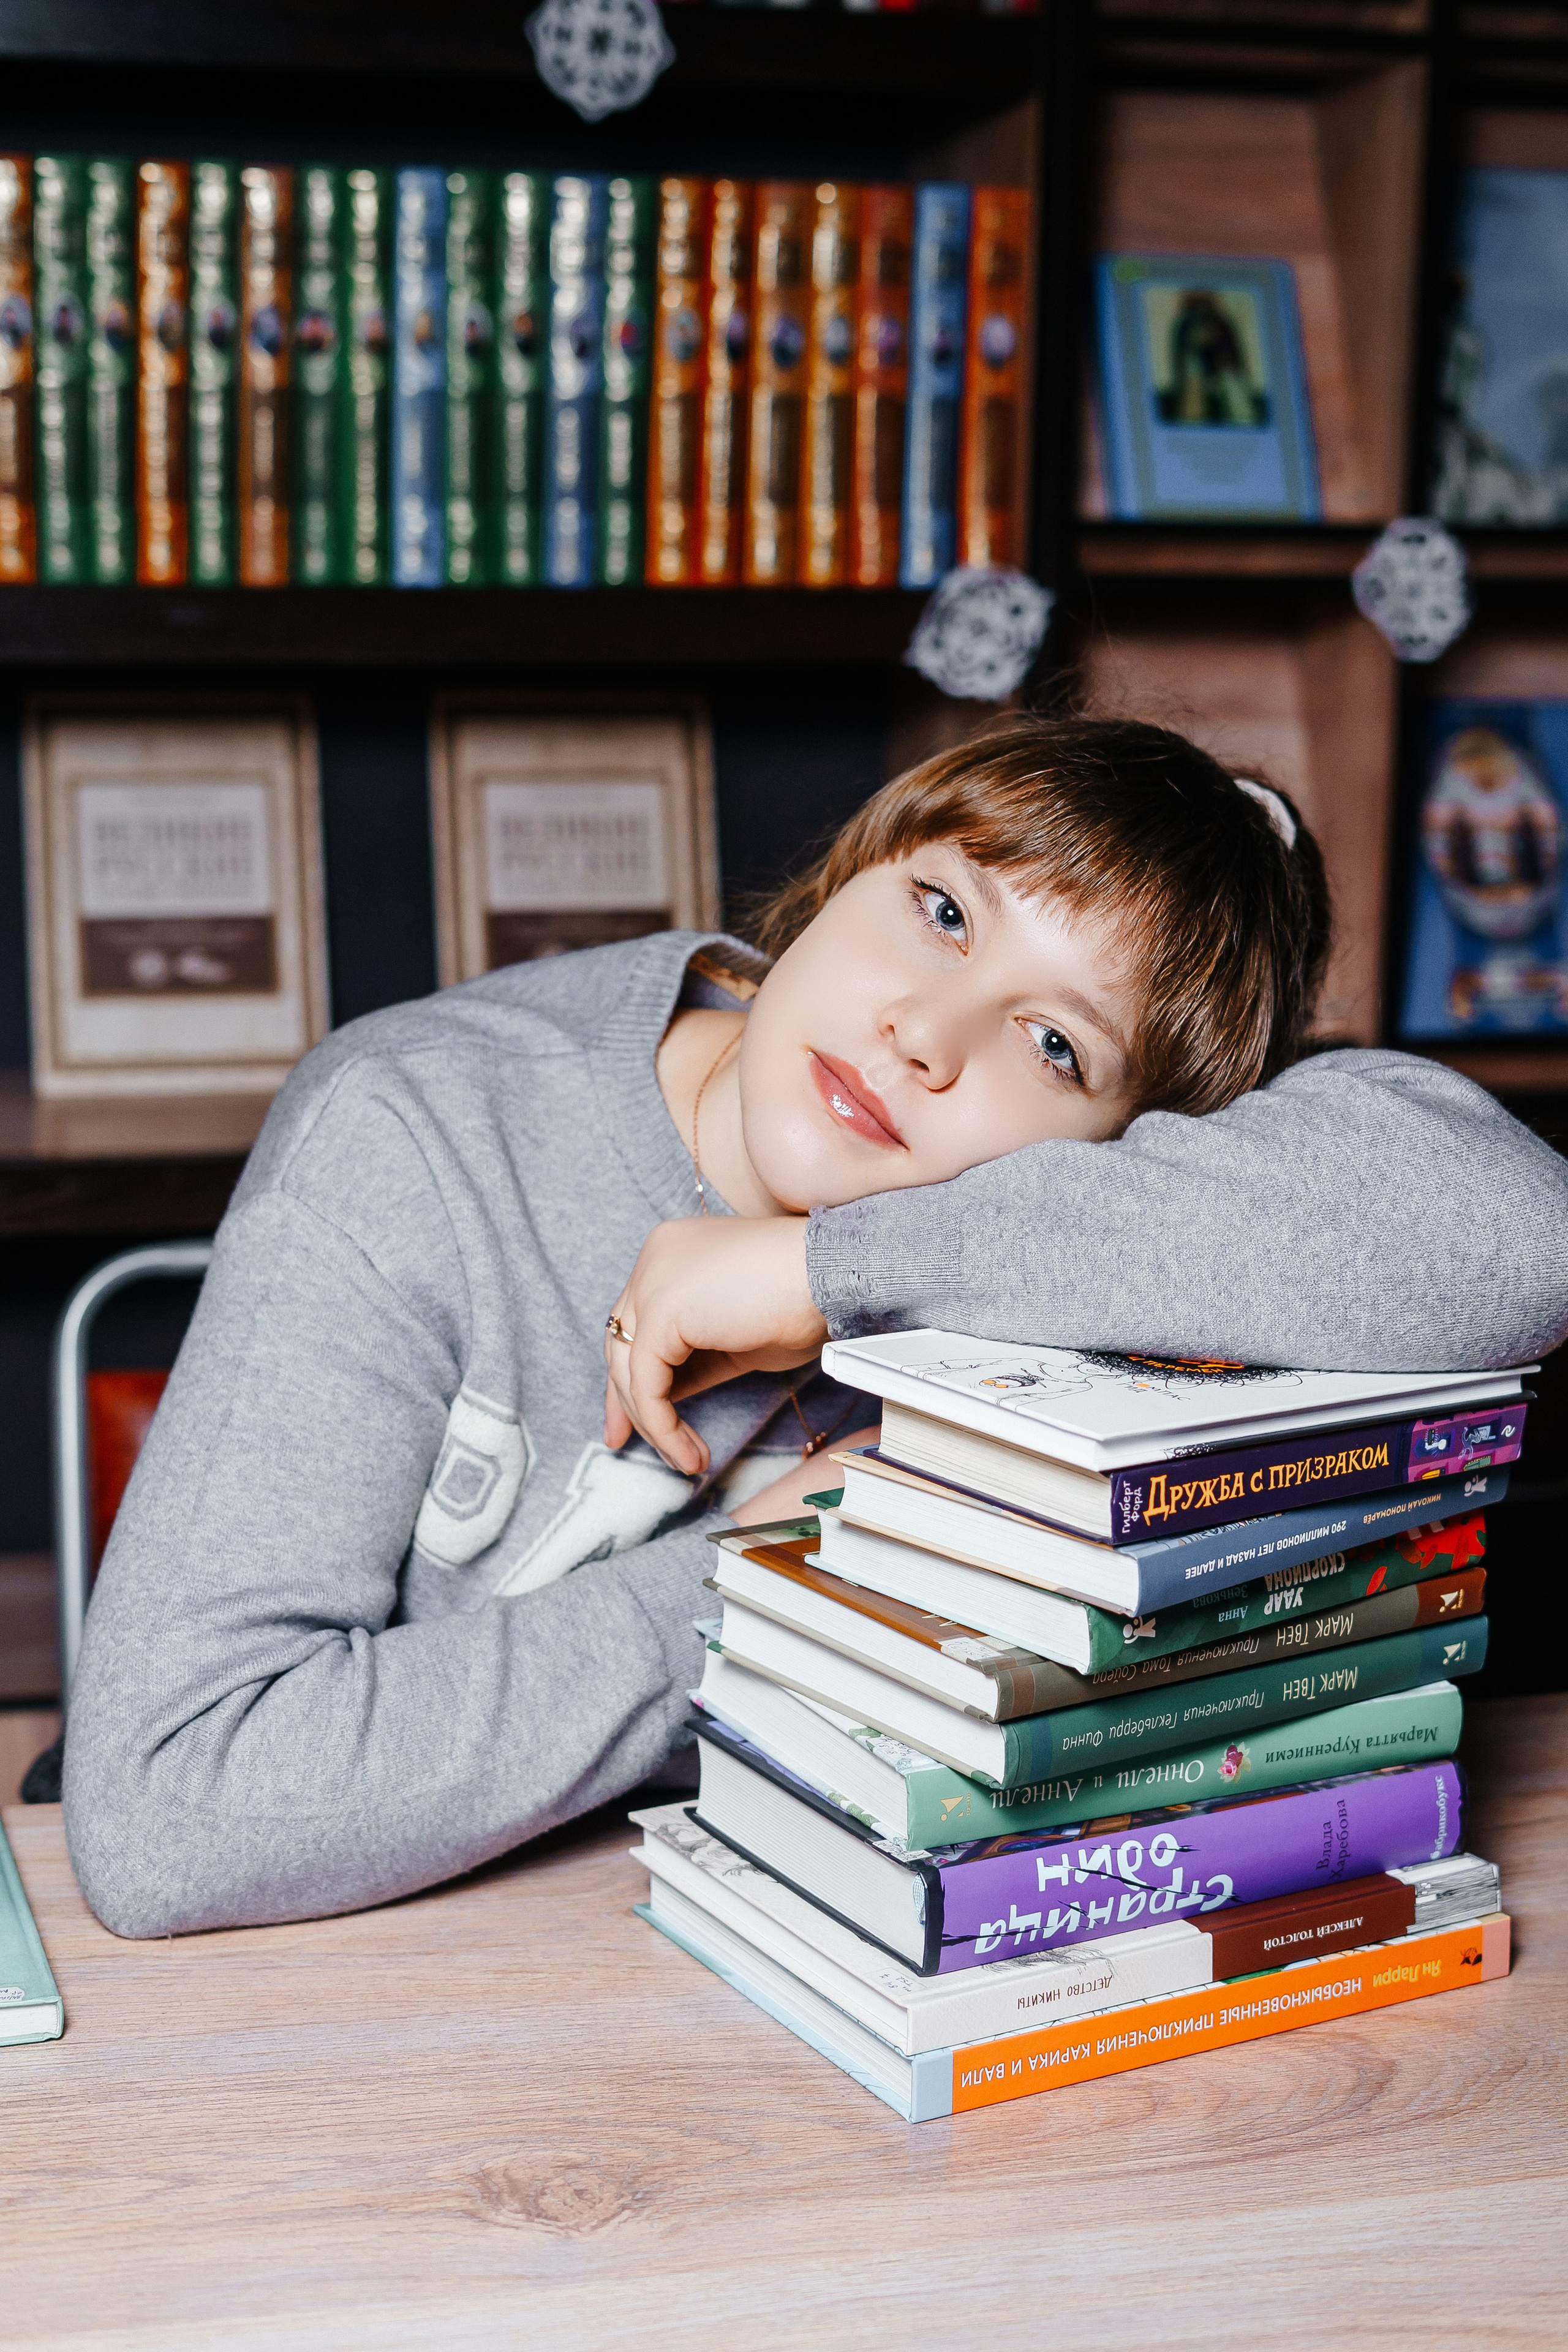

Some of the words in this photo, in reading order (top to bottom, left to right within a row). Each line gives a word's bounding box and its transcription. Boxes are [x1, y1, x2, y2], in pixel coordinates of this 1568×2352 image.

[1143, 1360, 1224, 1373] ПЕРЕМЕН
[1267, 1442, 1390, 1491] ПРИЗРАКОМ
[1130, 1487, 1144, 1522] Форд
[1362, 1502, 1407, 1525] ПОНОМАРЁВ
[1408, 1493, 1442, 1513] НИКОЛАЙ
[1276, 1523, 1330, 1552] МИЛЛИОНОВ
[1331, 1520, 1347, 1534] 290
[1226, 1548, 1256, 1567] НАЗАД
[1257, 1541, 1275, 1557] ЛЕТ
[1185, 1561, 1216, 1580] ДАЛЕЕ
[1217, 1558, 1224, 1569] И
[1264, 1552, 1346, 1592] СКОРПИОНА
[1193, 1584, 1248, 1608] Зенькова
[1264, 1586, 1304, 1616] УДАР
[1218, 1605, 1249, 1623] Анна
[1177, 1635, 1260, 1666] Приключения
[1142, 1658, 1172, 1675] Тома
[1183, 1691, 1265, 1721] Приключения
[1109, 1712, 1178, 1740] Гекльберри
[1366, 1725, 1438, 1748] Марьятта
[1062, 1728, 1103, 1751] Финна
[1265, 1735, 1360, 1763] Куренниеми
[1093, 1775, 1103, 1788] и
[1117, 1759, 1205, 1789] Оннели
[989, 1778, 1084, 1809] Аннели
[1316, 1820, 1333, 1870] Влада
[1329, 1799, 1351, 1880] Харебова
[1316, 1917, 1364, 1939] АЛЕКСЕЙ
[1263, 1930, 1314, 1951] ТОЛСТОЙ
[1373, 1964, 1420, 1988] Ларри
[1422, 1959, 1442, 1978] Ян
[1066, 1975, 1114, 1998] ДЕТСТВО
[1017, 1988, 1061, 2010] НИКИТЫ
[1219, 1977, 1363, 2026] НЕОБЫКНОВЕННЫЕ
[1096, 2012, 1215, 2056] ПРИКЛЮЧЕНИЯ
[1011, 2057, 1023, 2076] И
[1028, 2041, 1090, 2071] КАРИКА
[960, 2062, 1006, 2089] ВАЛИ
